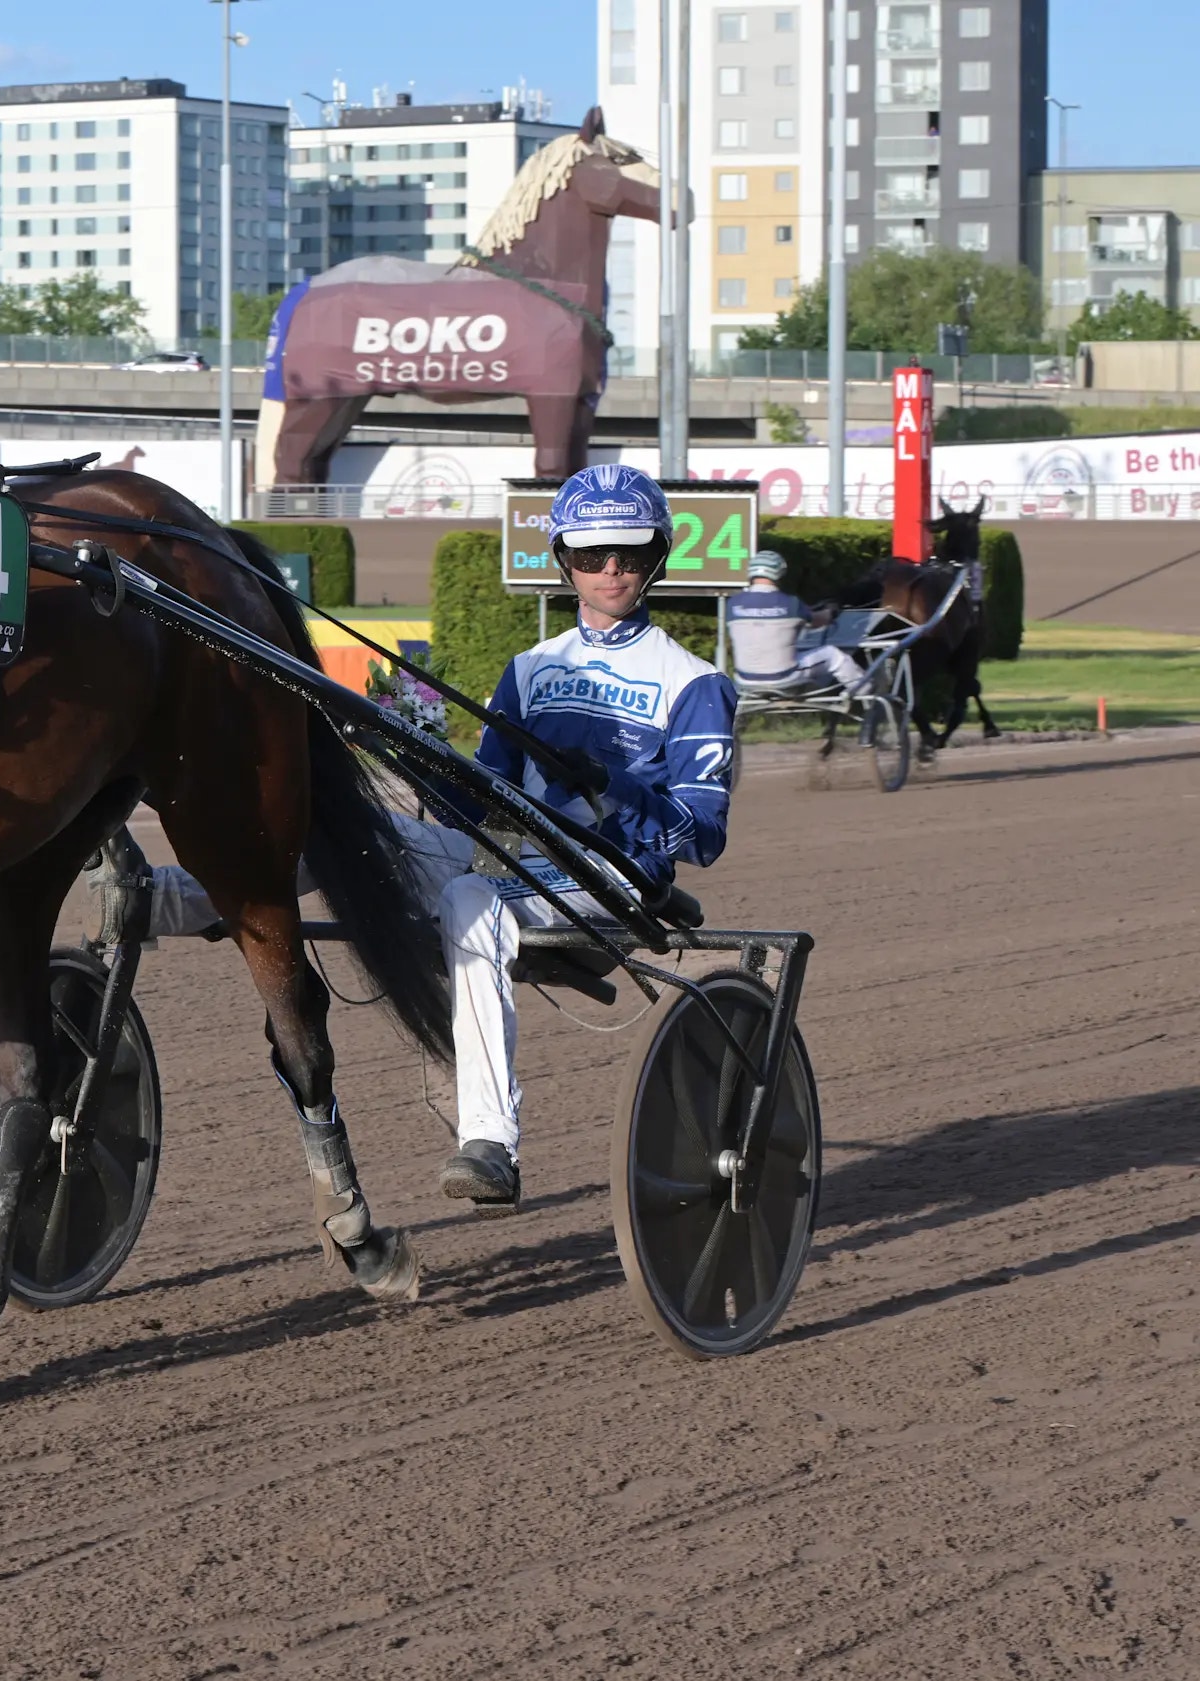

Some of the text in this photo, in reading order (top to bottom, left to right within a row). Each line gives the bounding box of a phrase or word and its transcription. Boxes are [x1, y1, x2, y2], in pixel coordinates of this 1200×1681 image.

[352, 314, 507, 354] BOKO
[355, 354, 508, 383] stables
[896, 373, 918, 460] MÅL
[1126, 447, 1200, 473] Be th
[580, 505, 634, 514] ÄLVSBYHUS
[1130, 488, 1179, 517] Buy
[513, 510, 551, 532] Lop
[513, 551, 549, 568] Def
[4, 625, 15, 636] CO
[532, 678, 649, 710] ÄLVSBYHUS
